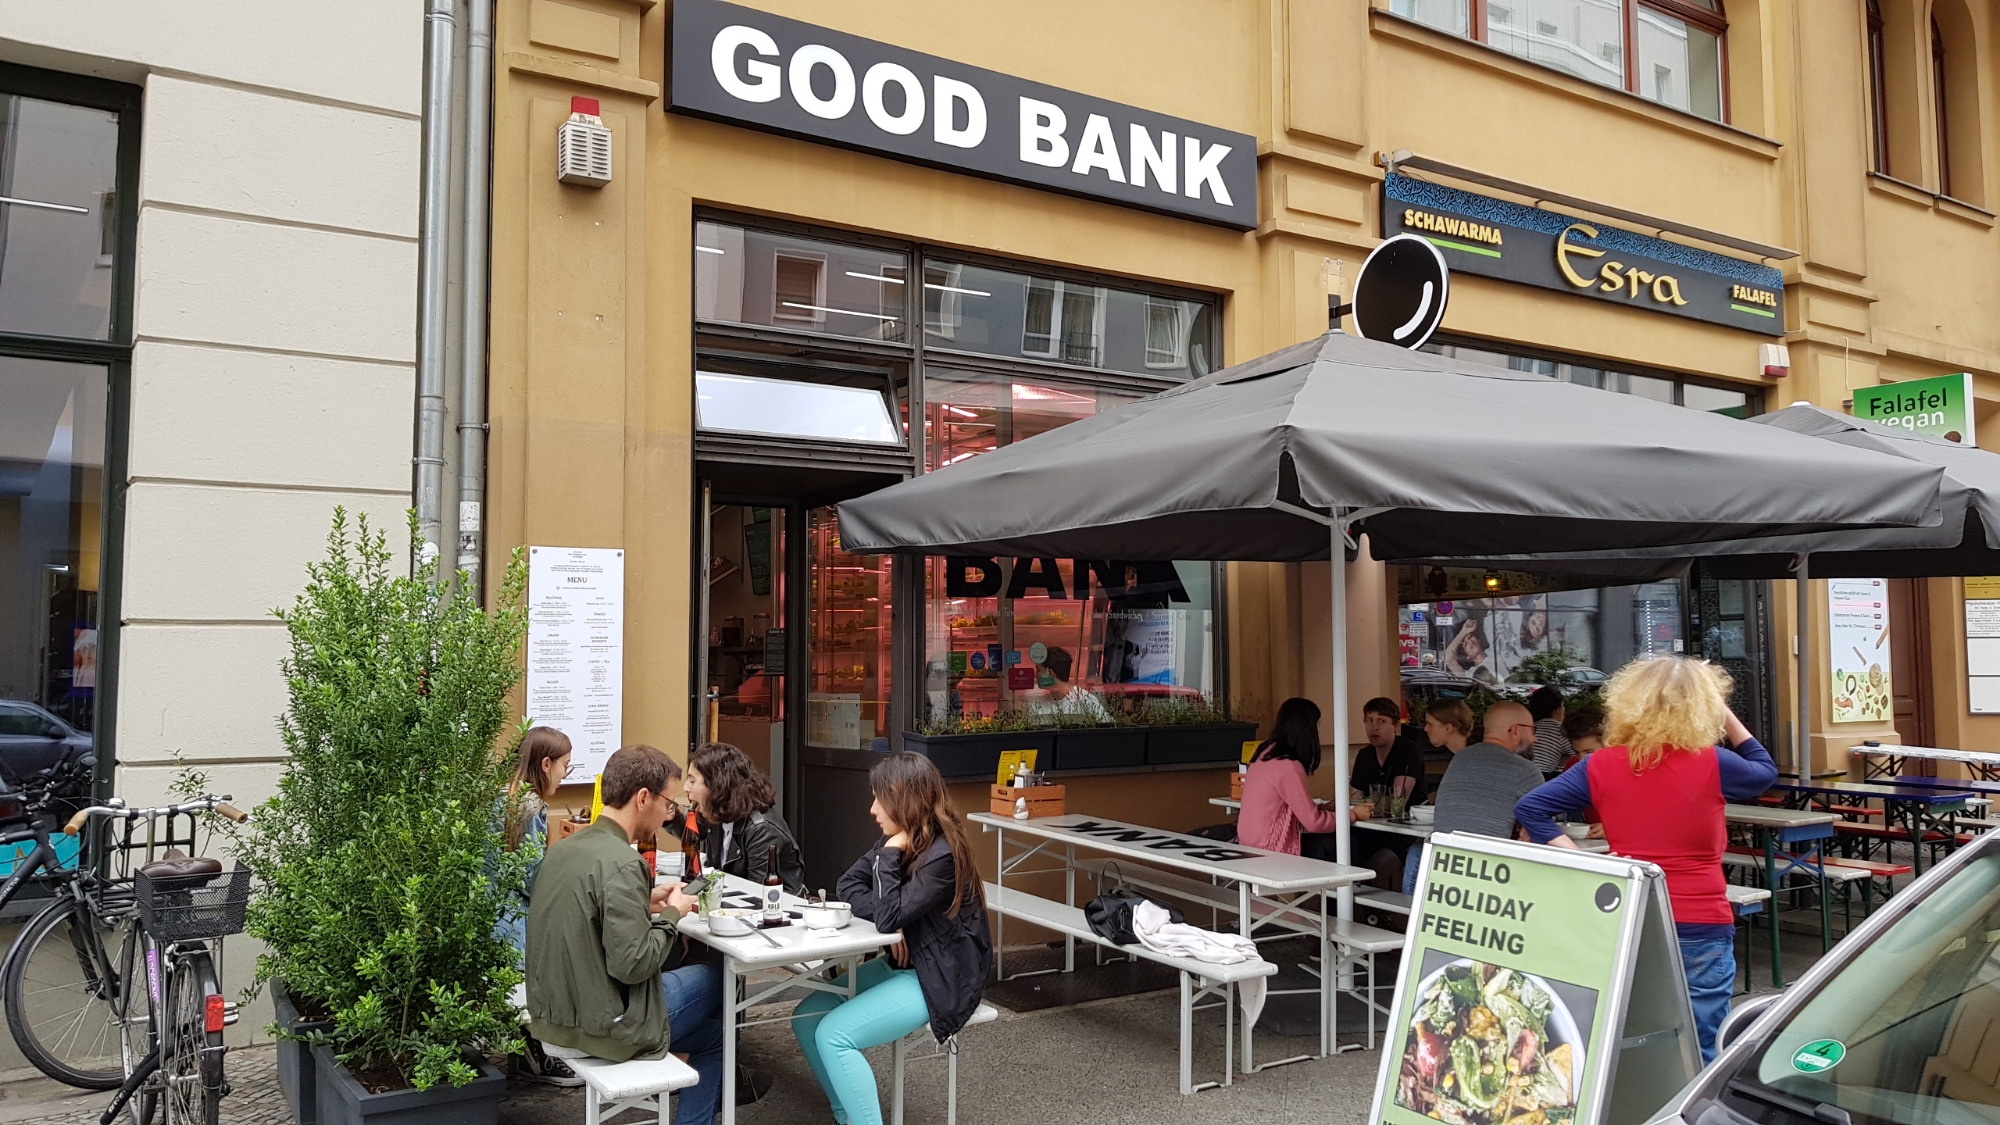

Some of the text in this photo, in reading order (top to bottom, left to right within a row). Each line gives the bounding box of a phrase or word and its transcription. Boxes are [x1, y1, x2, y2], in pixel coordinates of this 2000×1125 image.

[710, 25, 1234, 206] GOOD BANK
[1404, 208, 1503, 245] SCHAWARMA
[1557, 223, 1690, 305] Esra
[1733, 284, 1777, 307] FALAFEL
[1870, 387, 1947, 416] Falafel
[567, 576, 588, 584] MENU
[1044, 821, 1268, 861] BANK
[1433, 851, 1511, 884] HELLO
[1427, 882, 1534, 922] HOLIDAY
[1420, 913, 1525, 955] FEELING
[1815, 1042, 1835, 1056] 4
